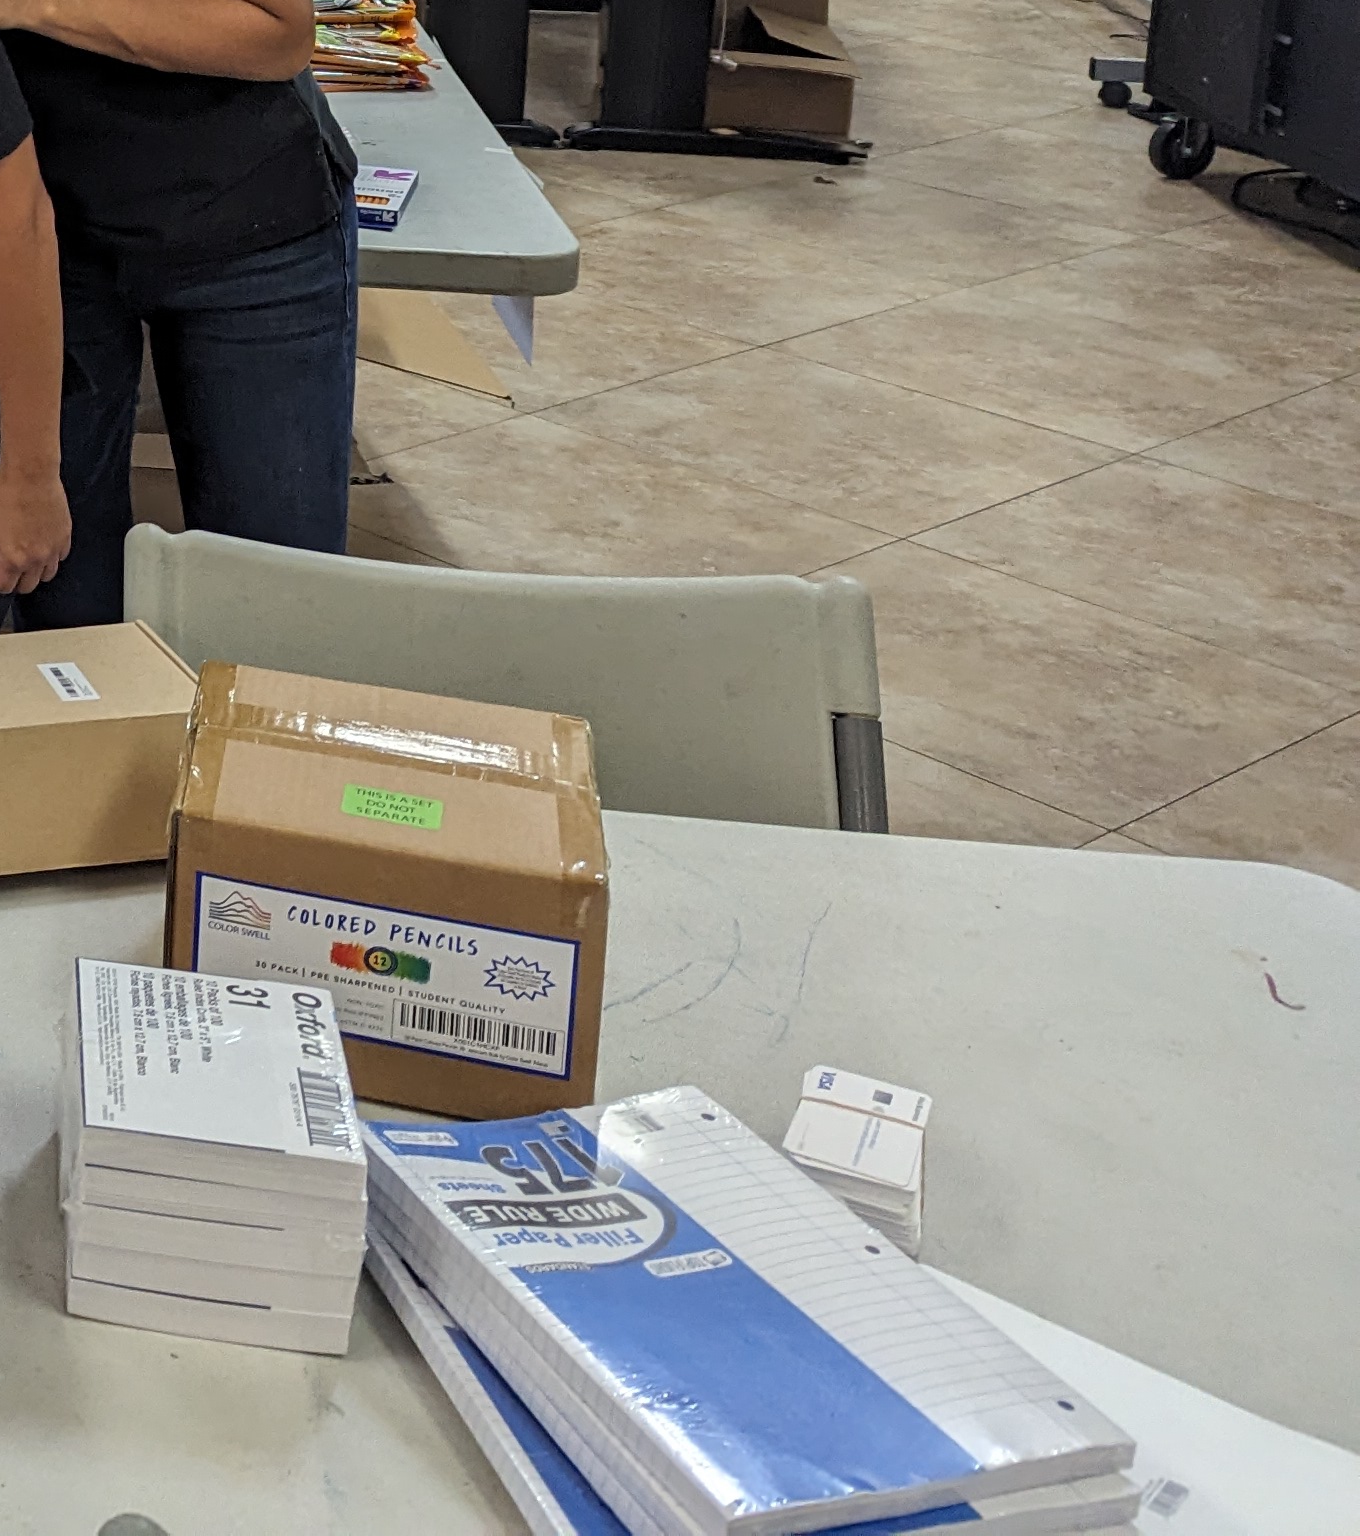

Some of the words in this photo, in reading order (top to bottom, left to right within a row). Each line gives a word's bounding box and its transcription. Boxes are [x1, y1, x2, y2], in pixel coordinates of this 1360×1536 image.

[356, 787, 383, 800] THIS
[385, 793, 397, 802] IS
[411, 798, 433, 809] SET
[366, 799, 387, 809] DO
[389, 803, 416, 814] NOT
[356, 807, 425, 825] SEPARATE
[239, 926, 272, 942] SWELL
[286, 904, 378, 937] COLORED
[389, 923, 479, 957] PENCILS
[372, 954, 387, 968] 12
[225, 983, 272, 1010] 31
[270, 962, 299, 976] PACK
[311, 971, 331, 982] PRE
[333, 974, 396, 995] SHARPENED
[407, 989, 456, 1007] STUDENT
[459, 1000, 507, 1015] QUALITY
[292, 990, 333, 1061] Oxford
[480, 1137, 626, 1197] 175
[466, 1204, 543, 1224] RULE
[551, 1195, 629, 1224] WIDE
[494, 1227, 572, 1249] Paper
[573, 1228, 644, 1249] Filler
